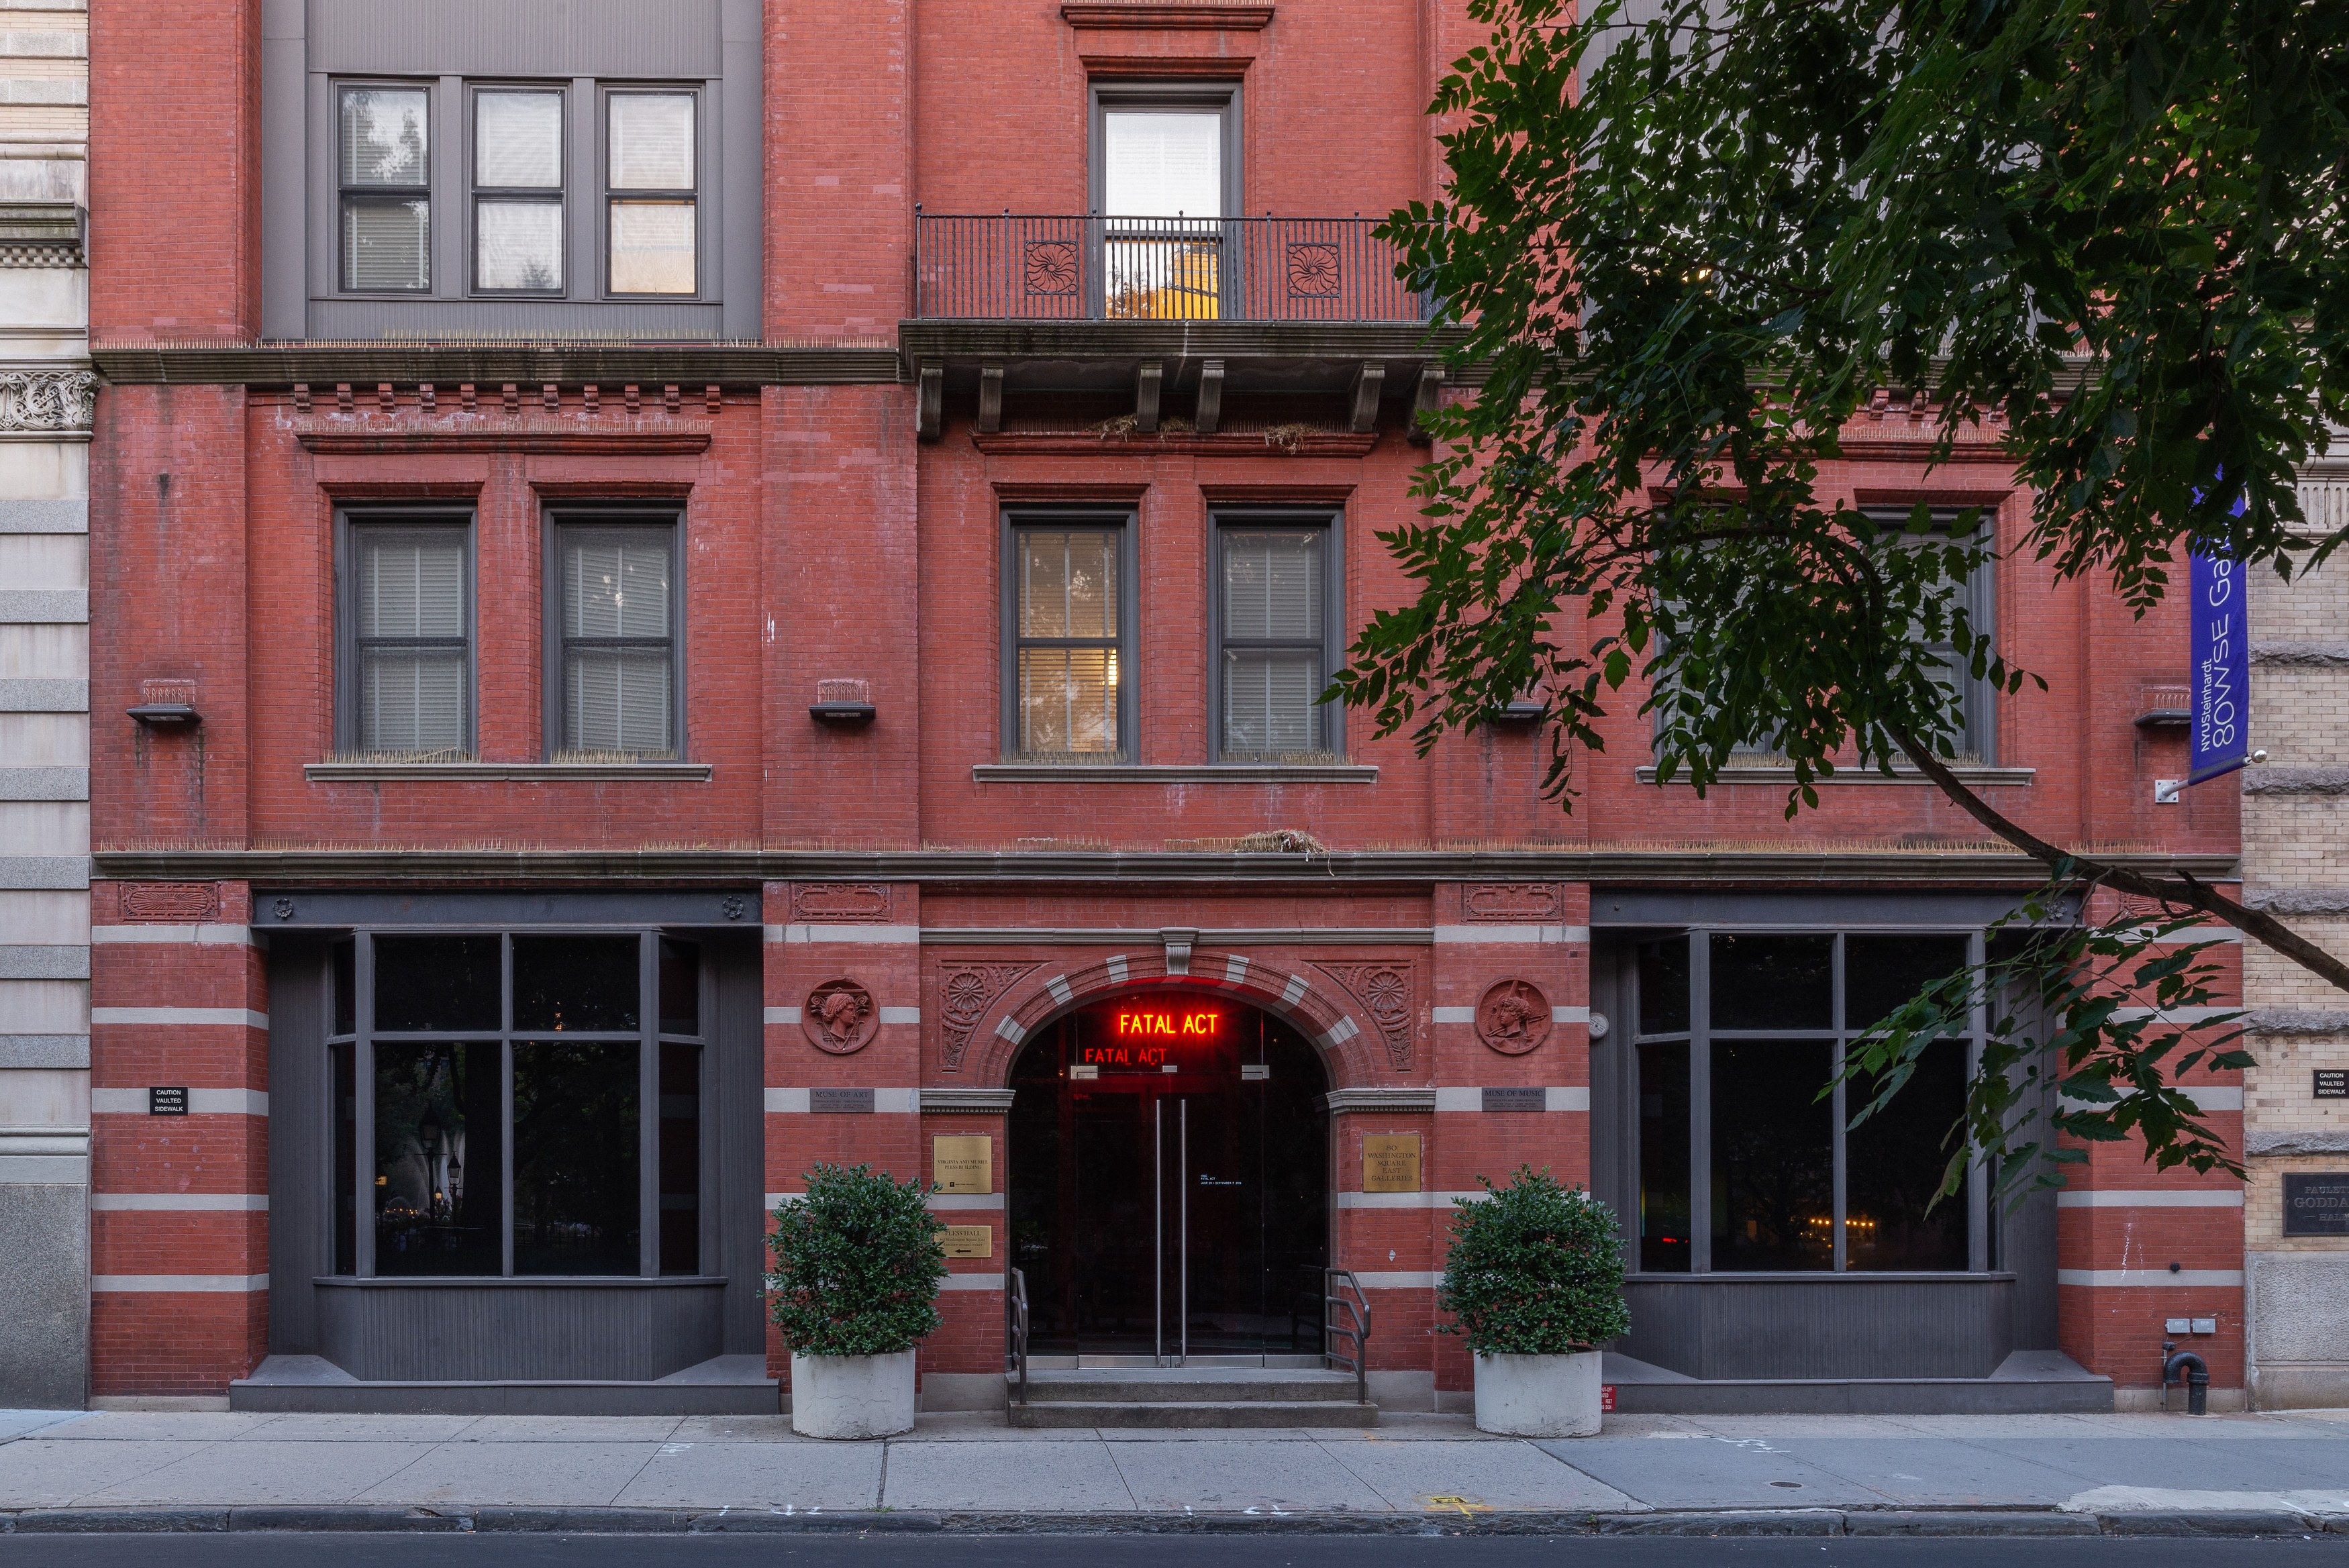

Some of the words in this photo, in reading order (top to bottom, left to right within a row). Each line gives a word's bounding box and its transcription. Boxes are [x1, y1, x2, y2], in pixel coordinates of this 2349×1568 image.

[2201, 658, 2212, 752] NYUSteinhardt
[1120, 1014, 1176, 1035] FATAL
[1183, 1014, 1218, 1035] ACT
[2304, 1186, 2349, 1194] PAULET
